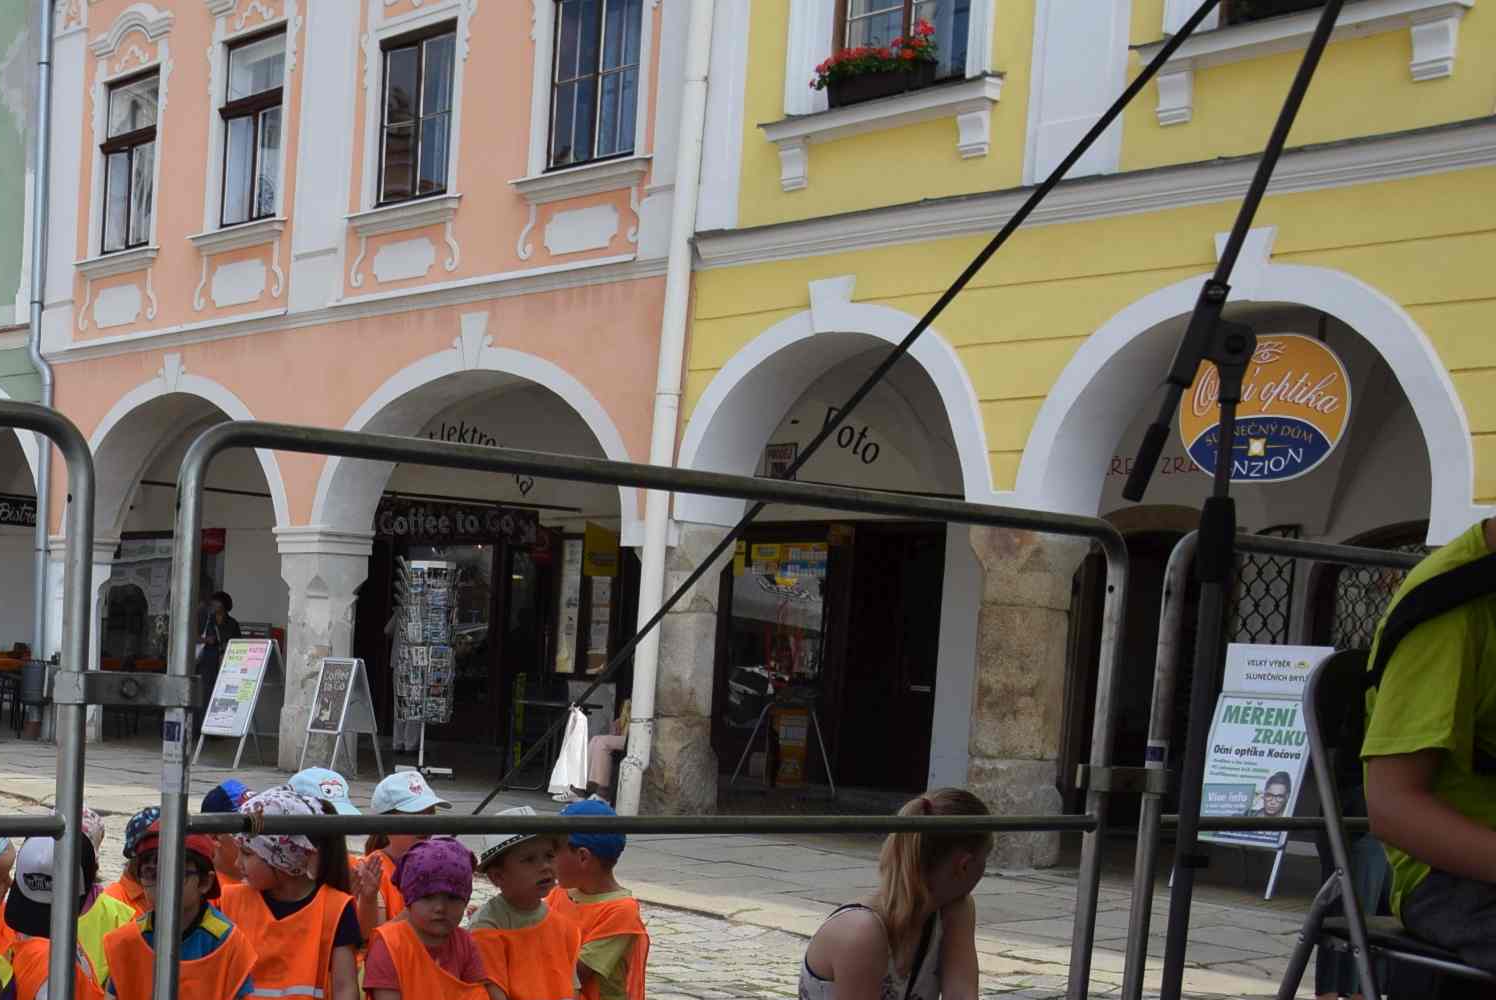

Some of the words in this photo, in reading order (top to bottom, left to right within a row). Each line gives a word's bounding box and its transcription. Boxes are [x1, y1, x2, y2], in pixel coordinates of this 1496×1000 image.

[1260, 368, 1340, 414] optika
[379, 506, 451, 536] Coffee
[455, 511, 480, 534] to
[1222, 701, 1299, 728] MĚŘENÍ
[1252, 727, 1307, 747] ZRAKU
[1213, 744, 1233, 755] Oční
[1234, 746, 1265, 758] optika
